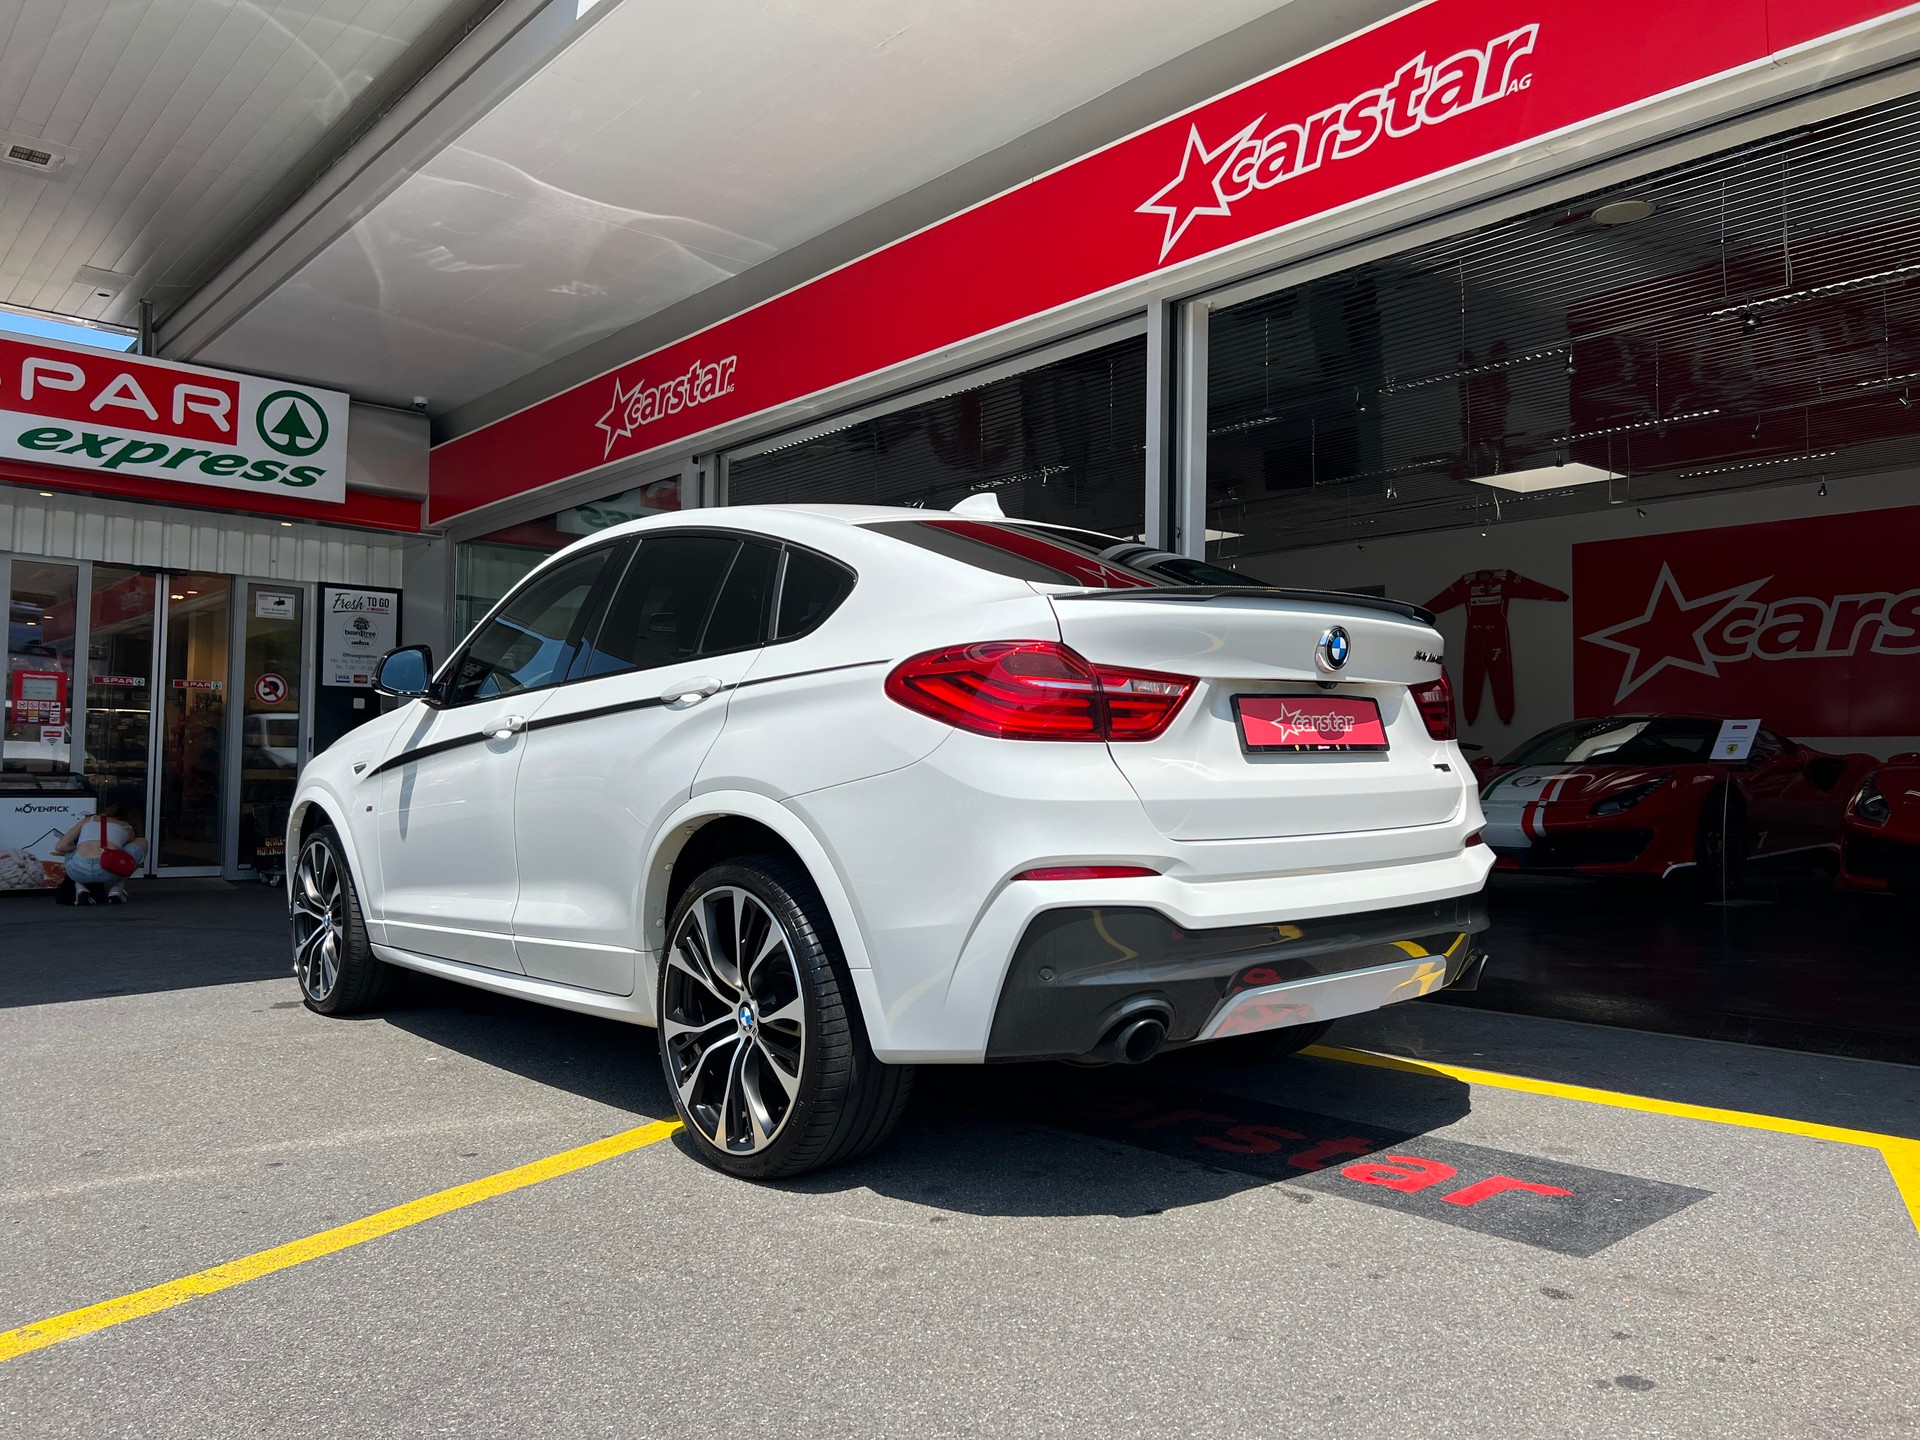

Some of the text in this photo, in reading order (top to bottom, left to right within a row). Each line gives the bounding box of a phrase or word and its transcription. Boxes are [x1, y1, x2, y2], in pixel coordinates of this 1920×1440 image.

[1215, 23, 1540, 201] carstar AG
[0, 357, 231, 432] PAR
[624, 355, 737, 429] carstar
[17, 427, 327, 488] express
[333, 592, 365, 610] Fresh
[367, 597, 377, 607] TO
[379, 598, 390, 608] GO
[1293, 711, 1354, 732] carstar
